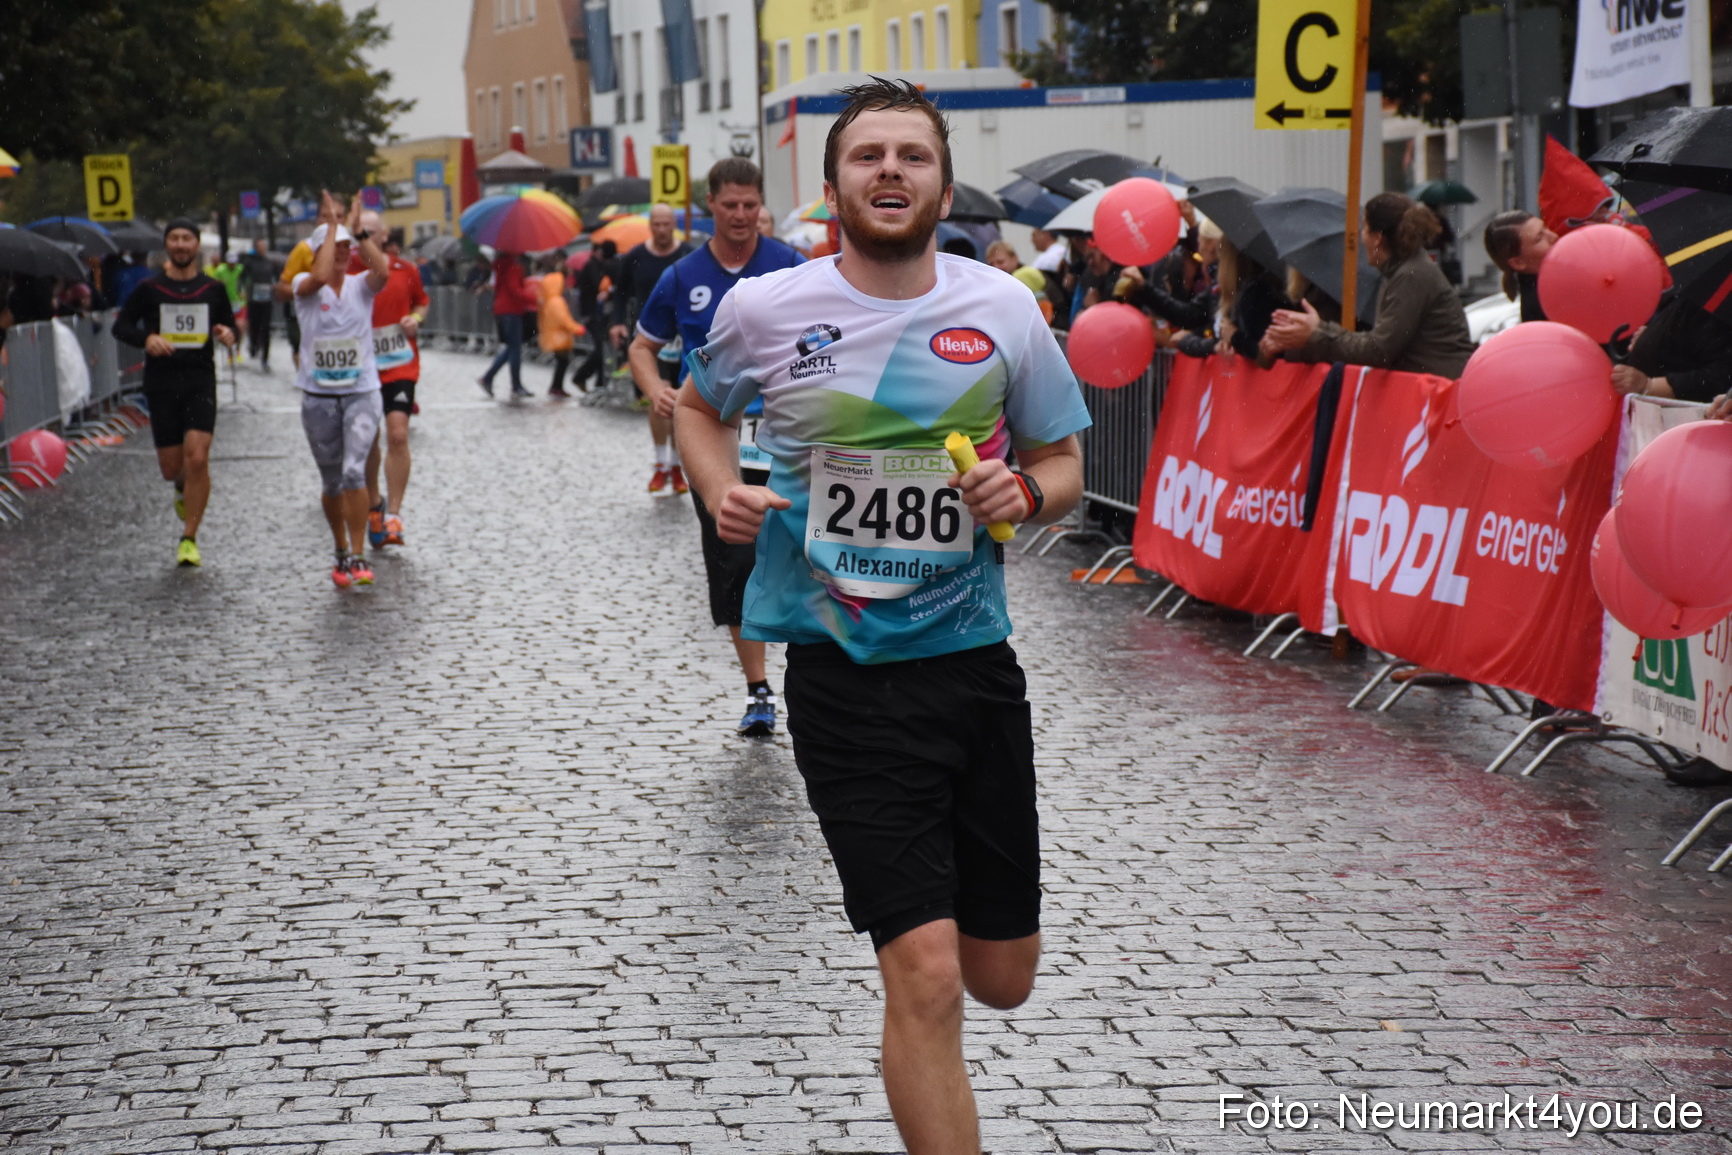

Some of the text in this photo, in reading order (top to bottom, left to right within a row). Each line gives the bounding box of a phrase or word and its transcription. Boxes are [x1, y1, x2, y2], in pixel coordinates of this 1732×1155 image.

[1285, 11, 1340, 94] C
[98, 174, 121, 206] D
[662, 164, 680, 195] D
[689, 285, 712, 312] 9
[176, 314, 195, 332] 59
[939, 336, 988, 354] Hervis
[315, 348, 357, 368] 3092
[790, 355, 837, 371] PARTL
[790, 367, 836, 380] Neumarkt
[823, 461, 873, 476] NeuerMarkt
[826, 483, 960, 544] 2486
[814, 528, 821, 539] C
[835, 551, 943, 579] Alexander
[909, 565, 982, 608] Neumarkter
